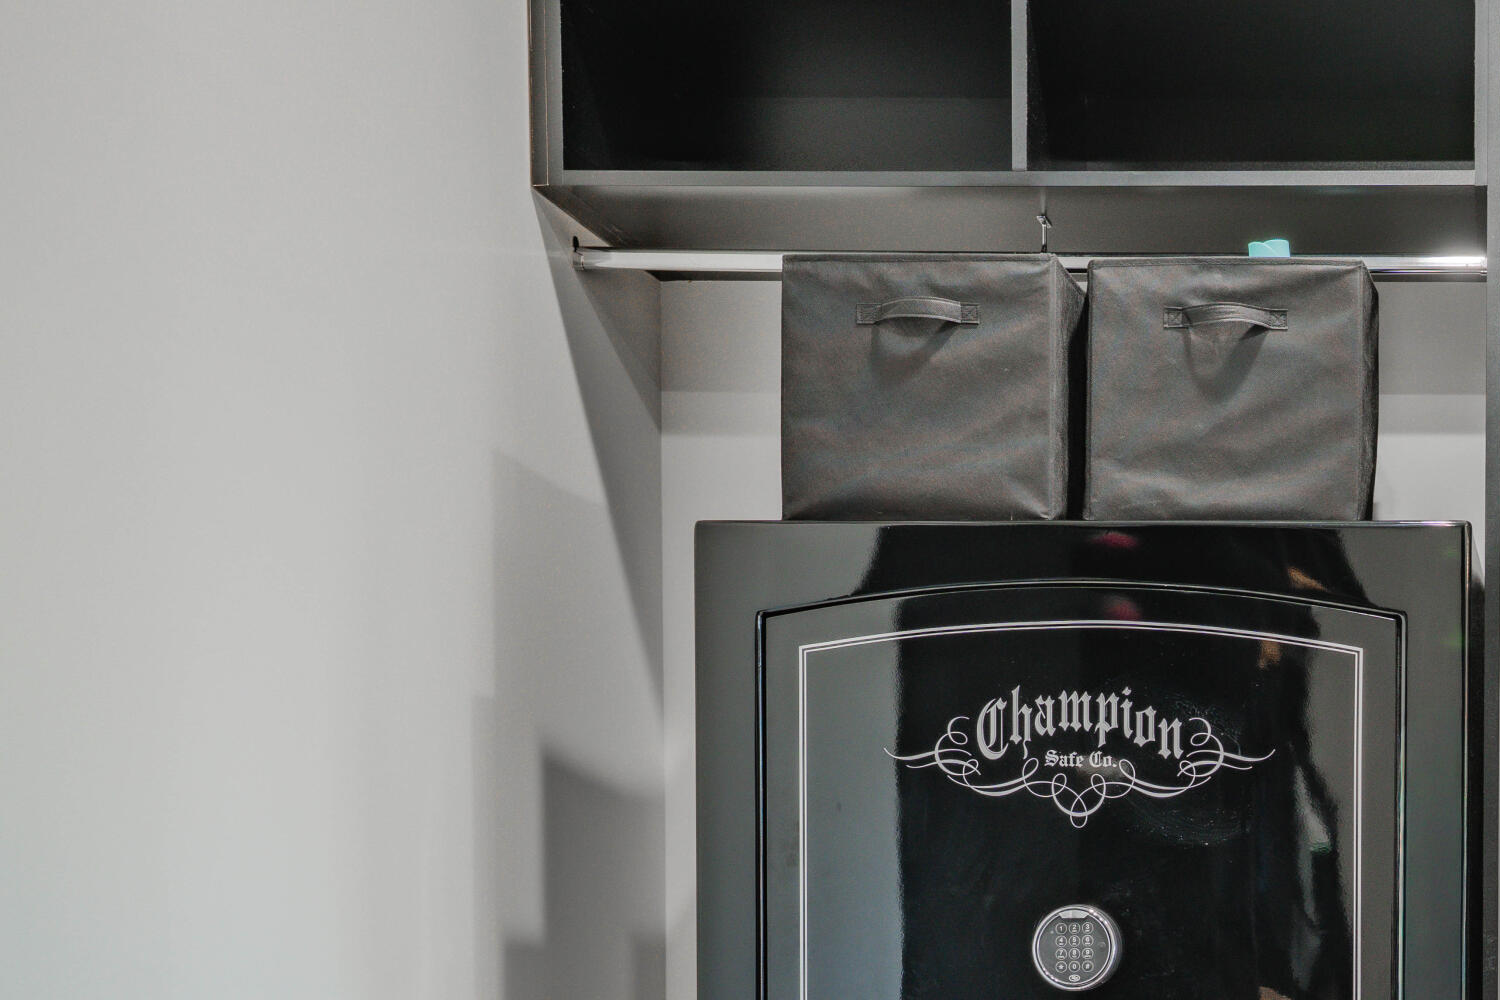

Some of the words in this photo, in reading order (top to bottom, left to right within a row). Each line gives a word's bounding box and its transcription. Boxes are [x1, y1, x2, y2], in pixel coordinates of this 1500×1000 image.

[976, 685, 1185, 761] Champion
[1044, 749, 1084, 768] Safe
[1088, 750, 1118, 768] Co.
